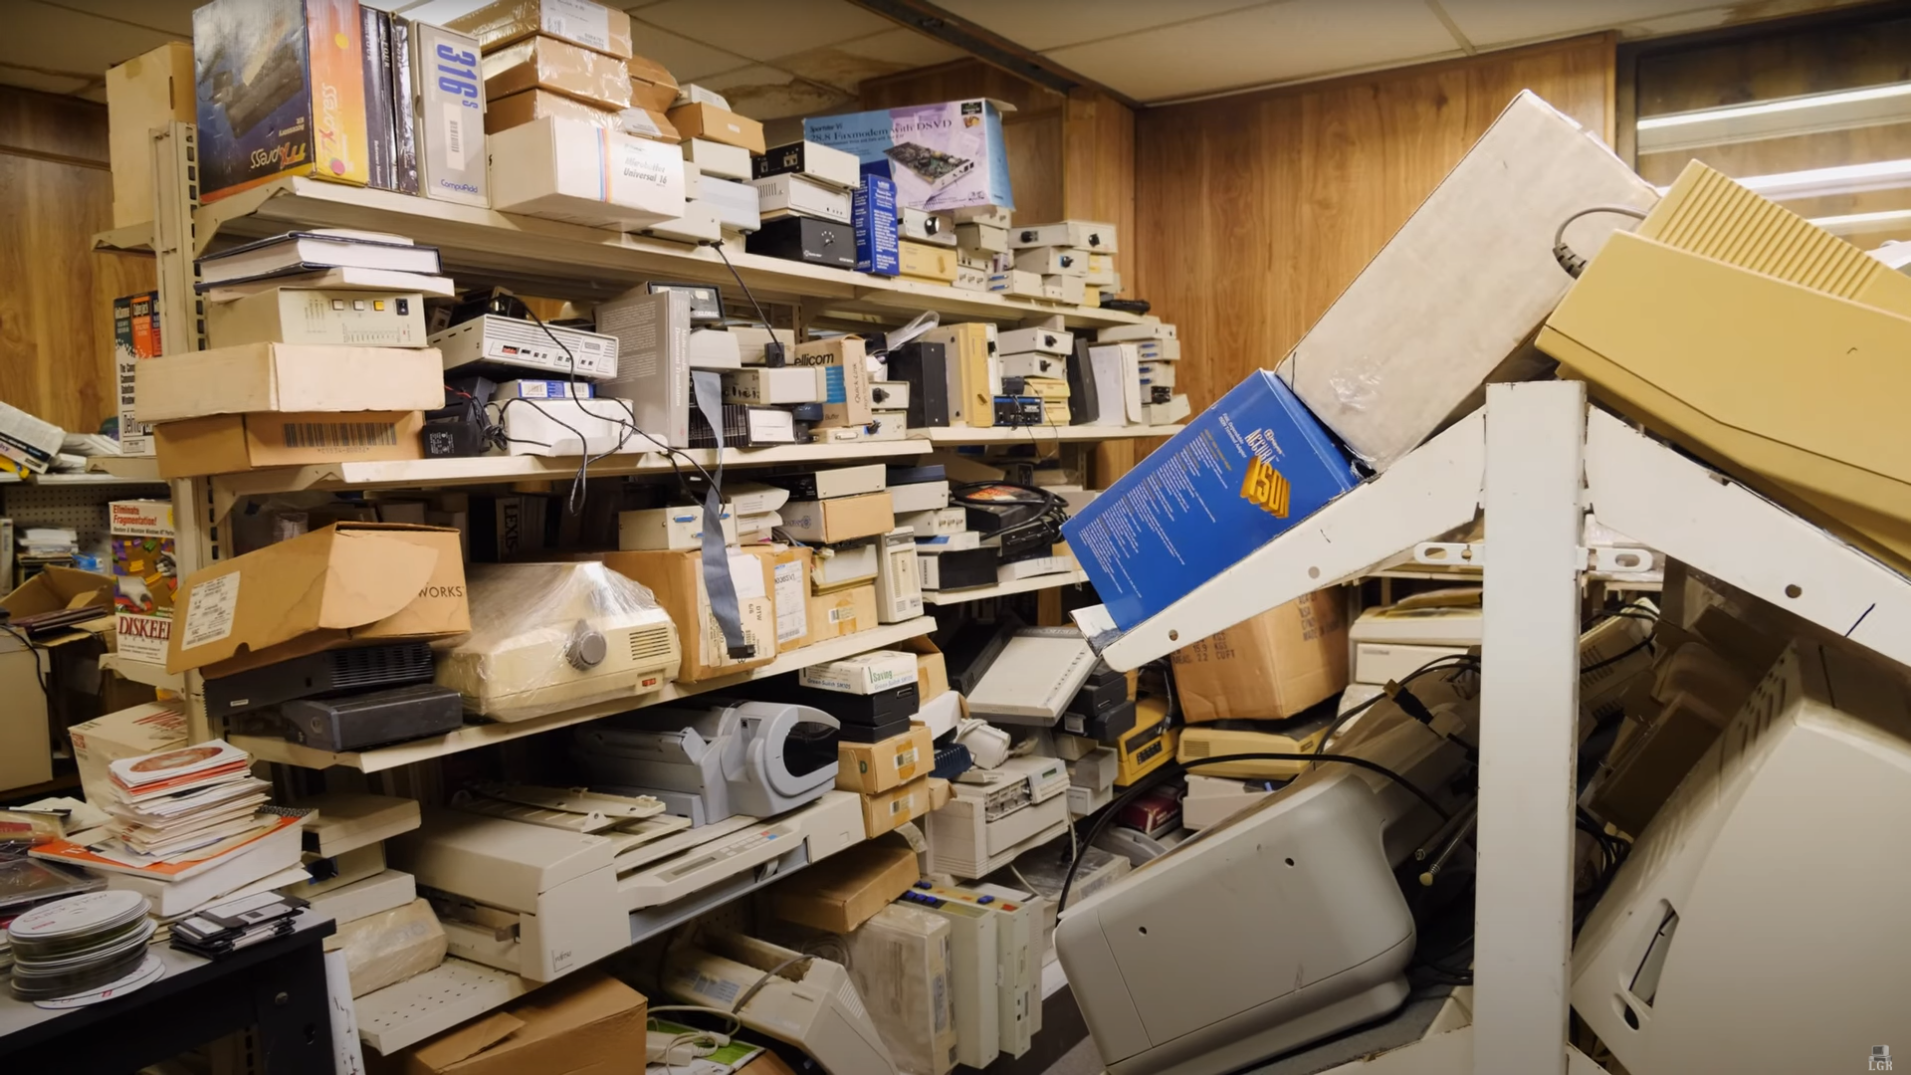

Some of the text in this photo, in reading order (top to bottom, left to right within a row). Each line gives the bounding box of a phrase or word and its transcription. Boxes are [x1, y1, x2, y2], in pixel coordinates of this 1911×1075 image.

[810, 119, 953, 142] 28.8 Faxmodem with DSVD
[623, 167, 668, 185] Universal 16
[440, 178, 479, 194] CompuAdd
[674, 327, 682, 364] Document
[794, 353, 834, 366] ellicom
[674, 366, 682, 406] Translation
[1240, 455, 1291, 519] ISDN
[113, 504, 140, 516] Eliminate
[113, 514, 158, 527] Fragmentation!
[418, 586, 463, 598] WORKS
[1214, 642, 1227, 650] KGS
[1216, 649, 1236, 660] CUFT
[873, 670, 893, 682] Saving
